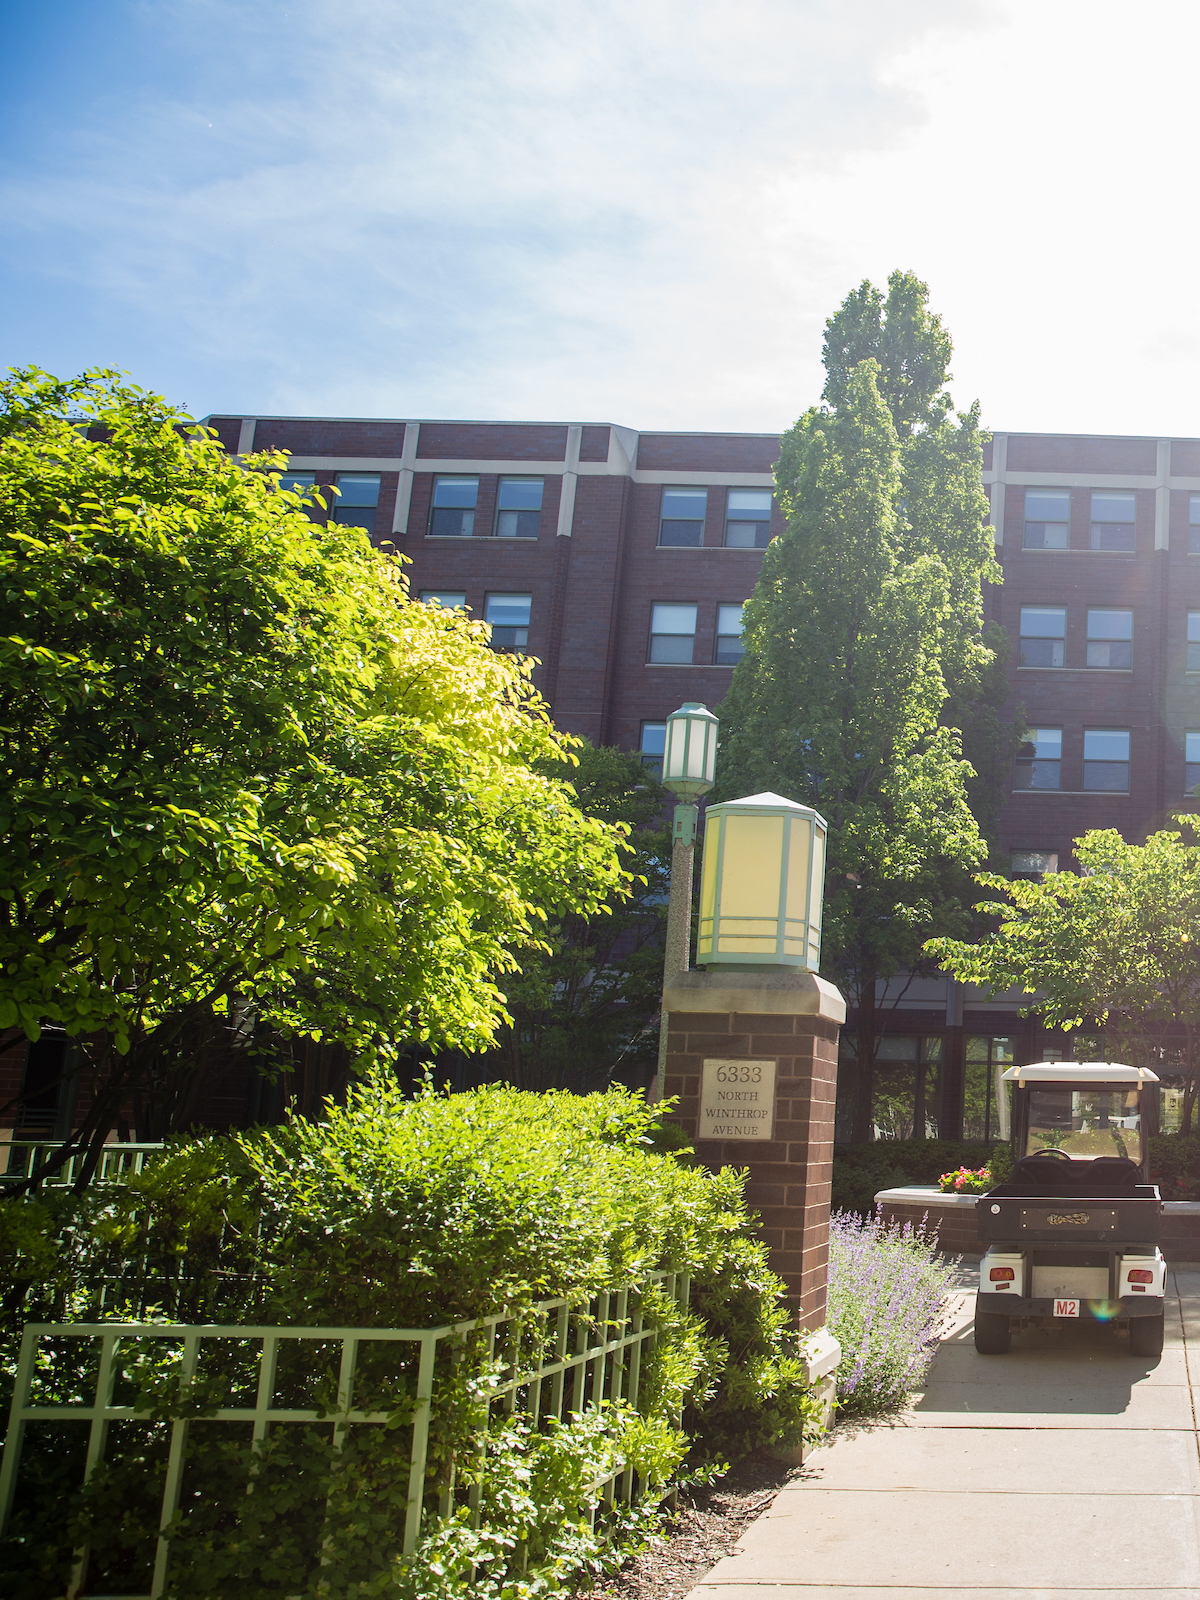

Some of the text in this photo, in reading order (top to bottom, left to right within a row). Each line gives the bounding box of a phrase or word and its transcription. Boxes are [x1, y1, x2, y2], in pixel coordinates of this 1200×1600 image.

[716, 1066, 762, 1083] 6333
[717, 1091, 759, 1101] NORTH
[705, 1108, 768, 1119] WINTHROP
[712, 1125, 759, 1135] AVENUE
[1056, 1301, 1076, 1315] M2
